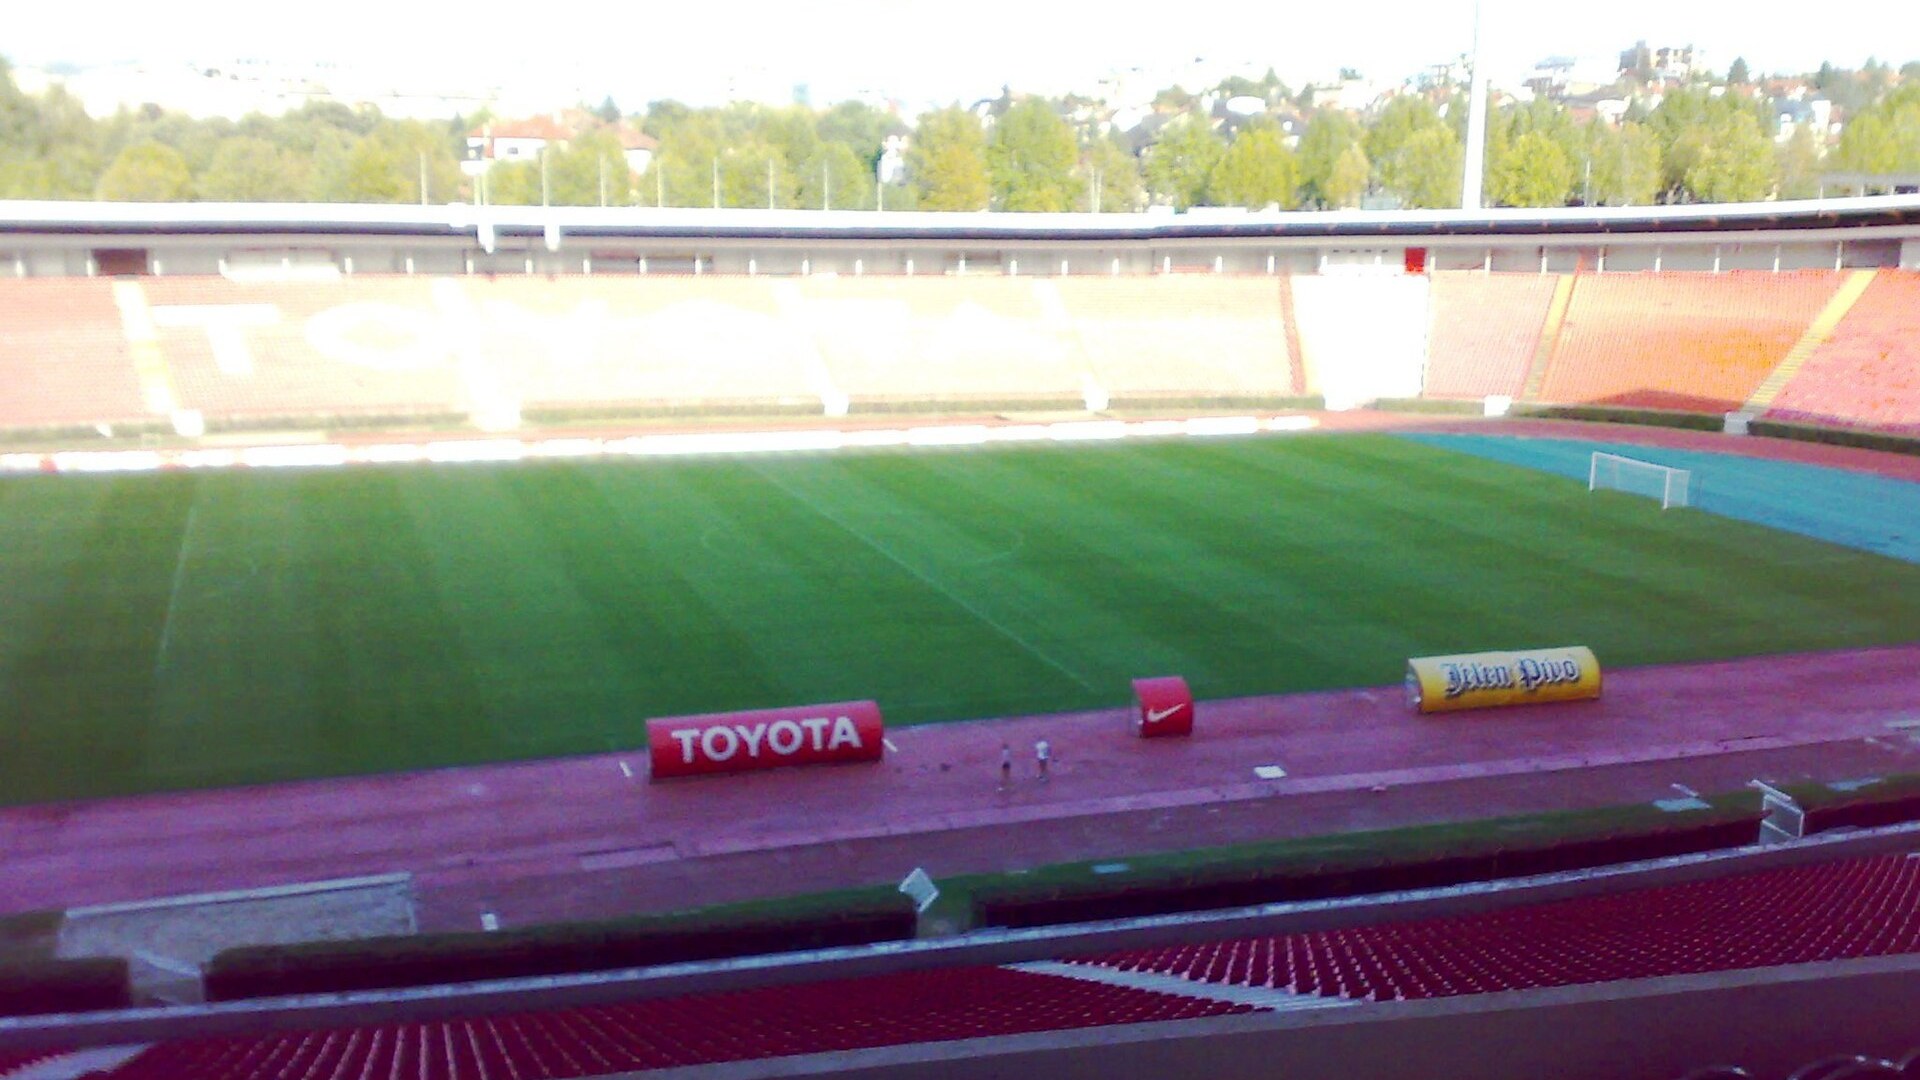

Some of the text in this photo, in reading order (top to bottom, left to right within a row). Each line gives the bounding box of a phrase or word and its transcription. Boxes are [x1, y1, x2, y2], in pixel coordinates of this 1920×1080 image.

[1440, 656, 1580, 697] Jelen Pivo
[671, 716, 862, 763] TOYOTA
